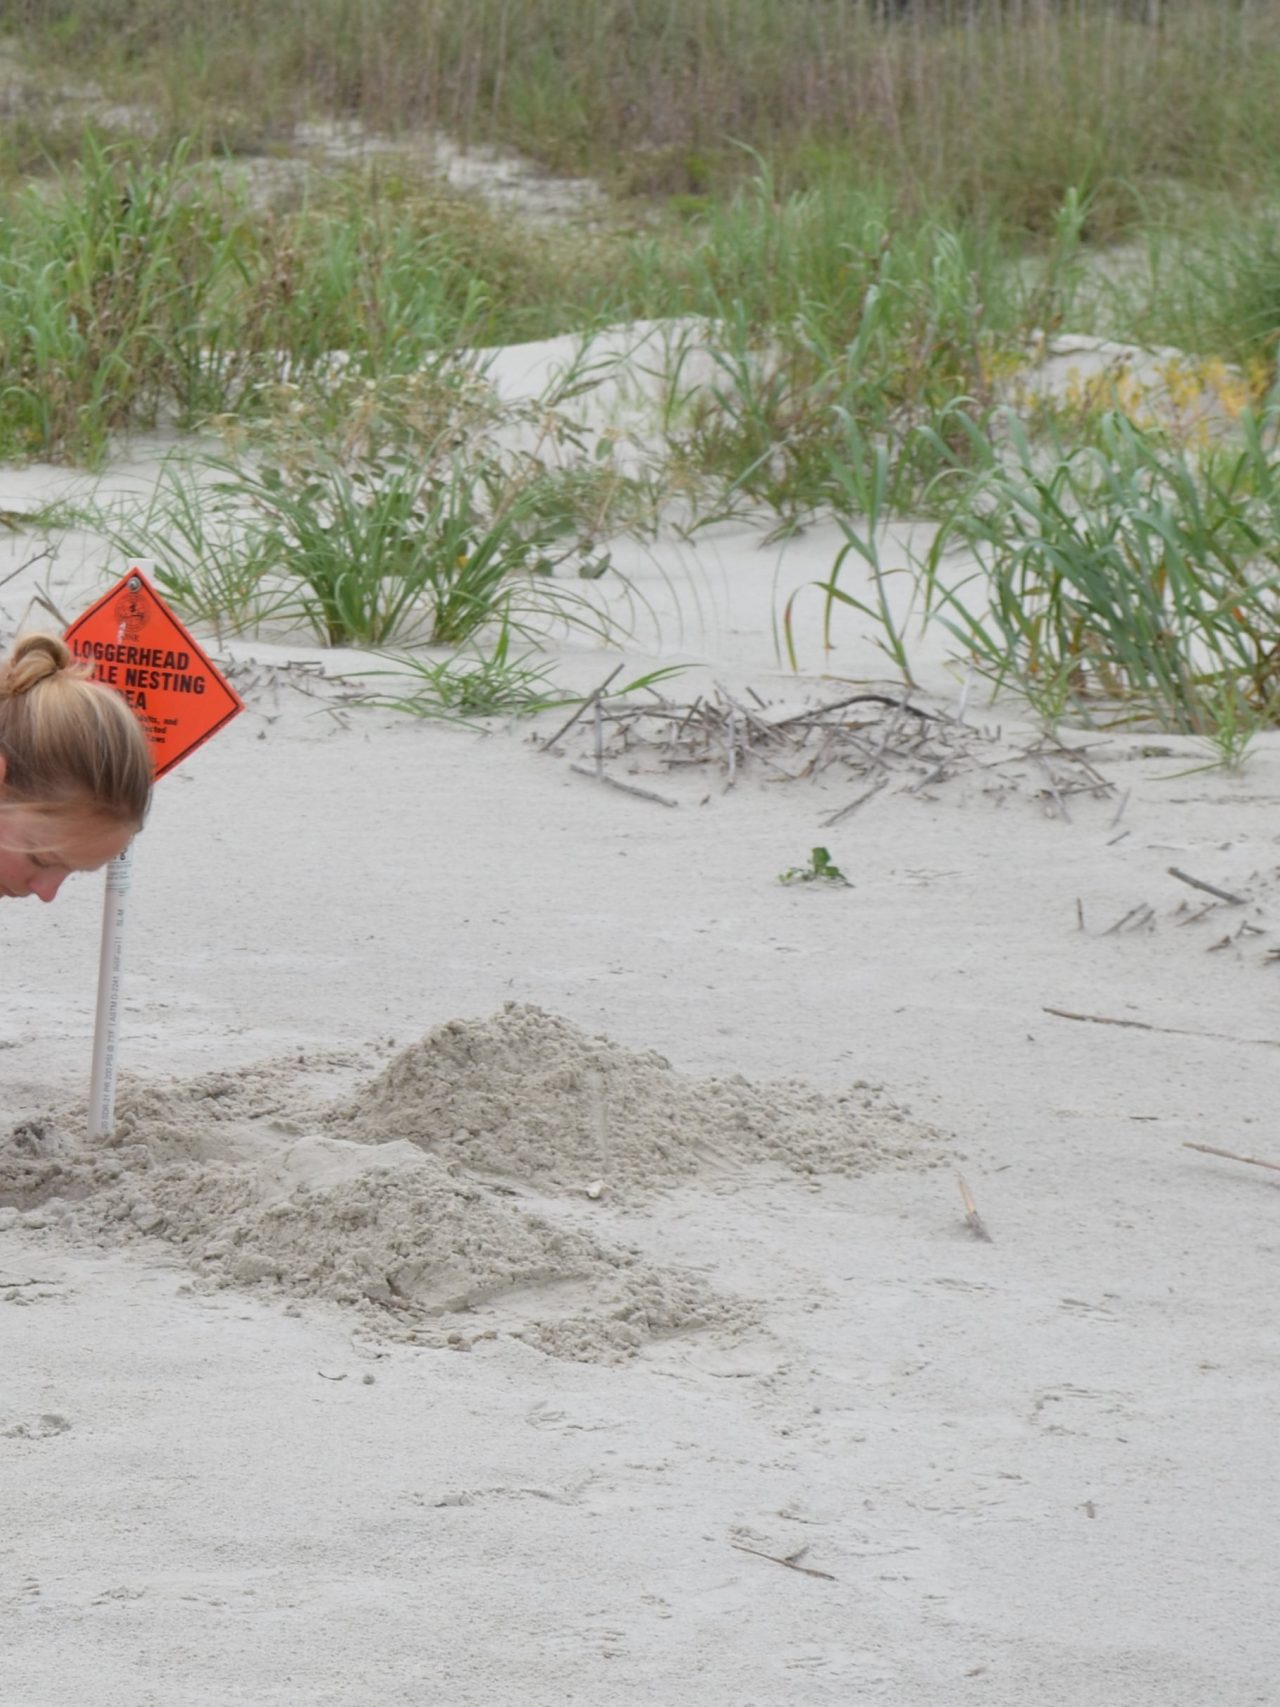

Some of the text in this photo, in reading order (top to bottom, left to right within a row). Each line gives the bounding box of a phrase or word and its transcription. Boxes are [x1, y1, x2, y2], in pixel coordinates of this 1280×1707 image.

[73, 640, 190, 671] LOGGERHEAD
[125, 668, 205, 695] NESTING
[117, 689, 147, 710] EA
